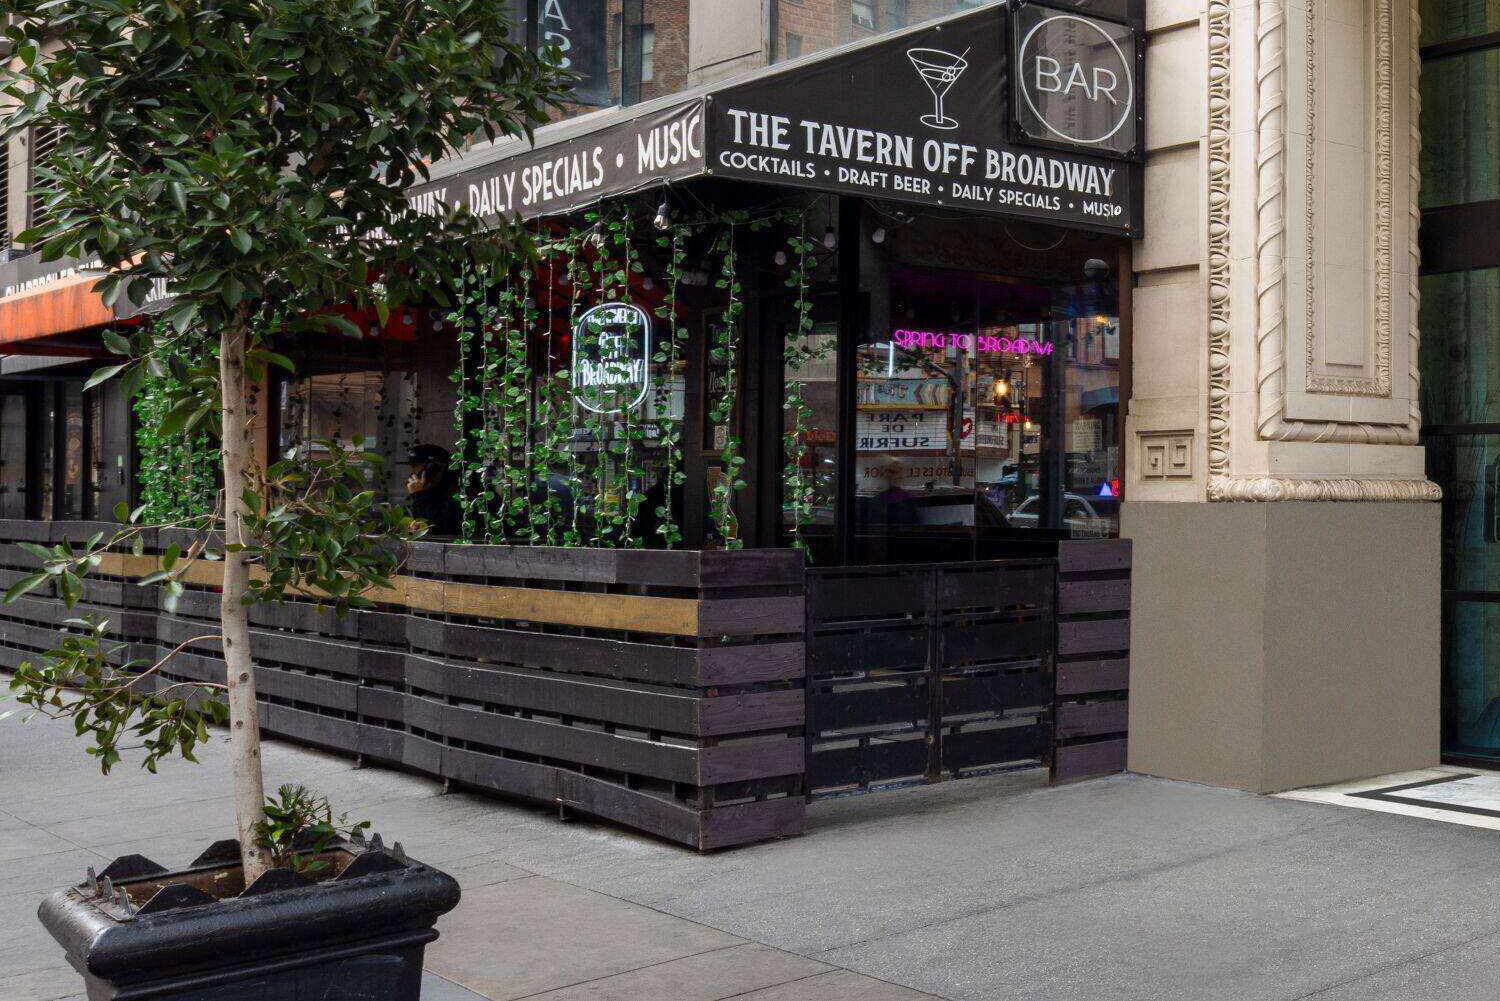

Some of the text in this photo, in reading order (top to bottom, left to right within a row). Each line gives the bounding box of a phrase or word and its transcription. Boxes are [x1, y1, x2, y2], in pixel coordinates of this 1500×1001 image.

[1036, 55, 1117, 105] BAR
[469, 172, 516, 218] DAILY
[522, 146, 604, 206] SPECIALS
[637, 115, 703, 175] MUSIC
[719, 150, 816, 178] COCKTAILS
[838, 166, 888, 189] DRAFT
[893, 174, 931, 195] BEER
[952, 182, 994, 203] DAILY
[998, 188, 1061, 211] SPECIALS
[727, 108, 1115, 196] THE TAVERN OFF BROADWAY
